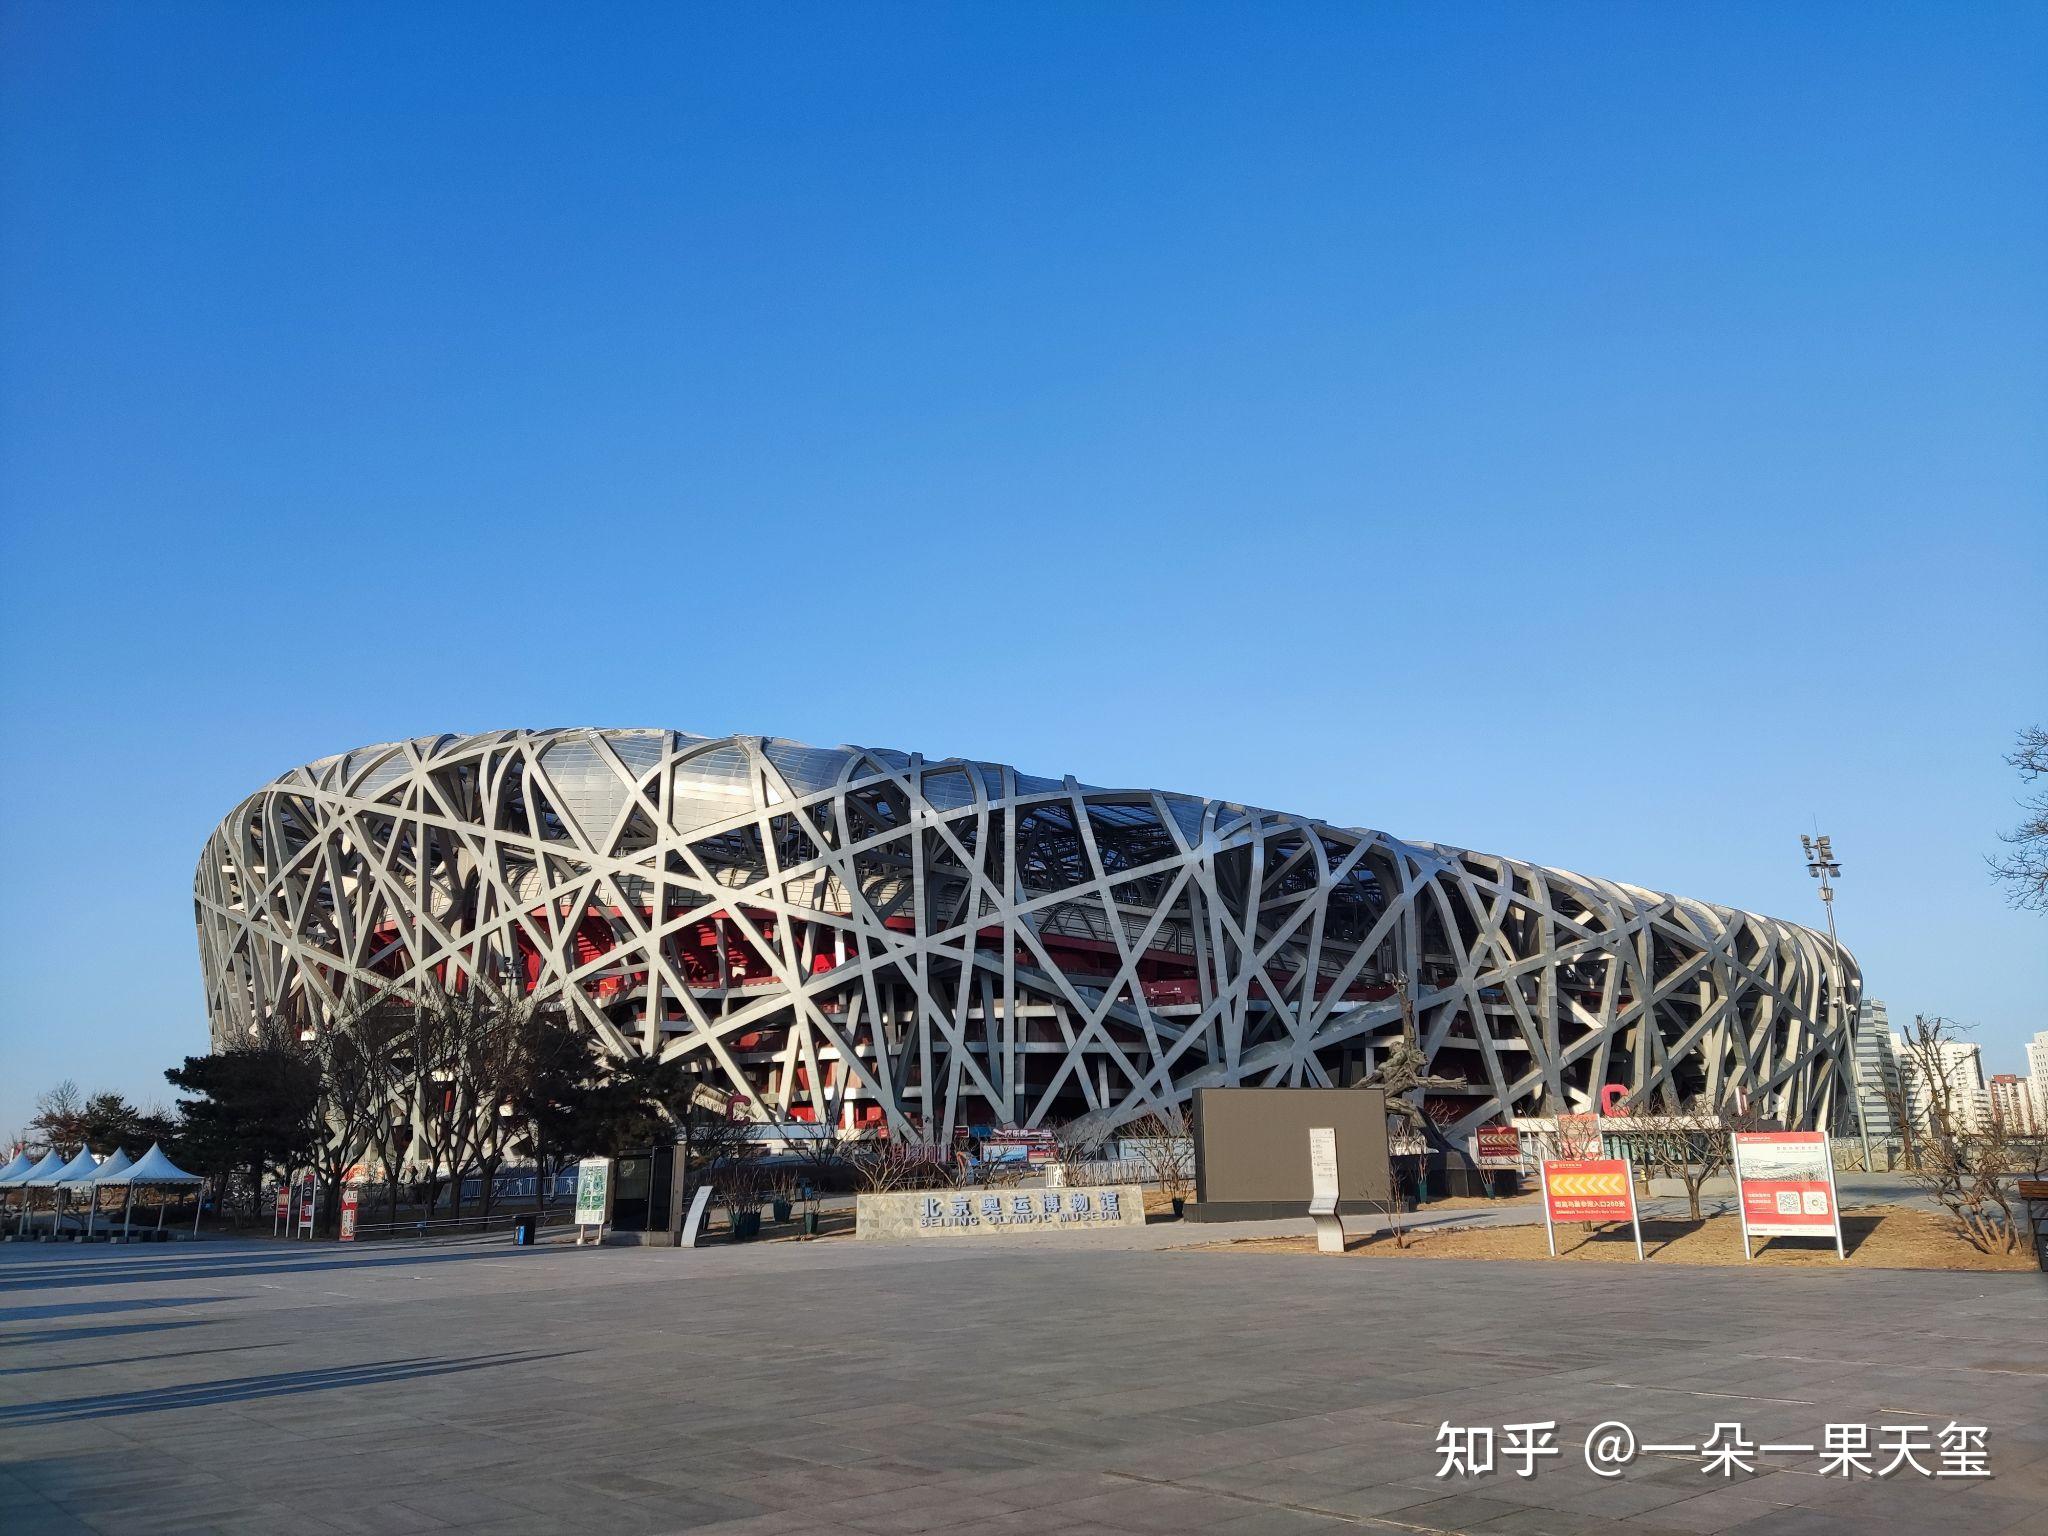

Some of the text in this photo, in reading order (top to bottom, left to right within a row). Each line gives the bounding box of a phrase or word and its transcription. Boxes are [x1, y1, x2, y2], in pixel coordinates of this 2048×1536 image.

[726, 1095, 751, 1126] C
[1601, 1084, 1629, 1117] C
[921, 1192, 1119, 1218] 北京奥运博物馆
[920, 1211, 1121, 1228] BEIJING OLYMPIC MUSEUM
